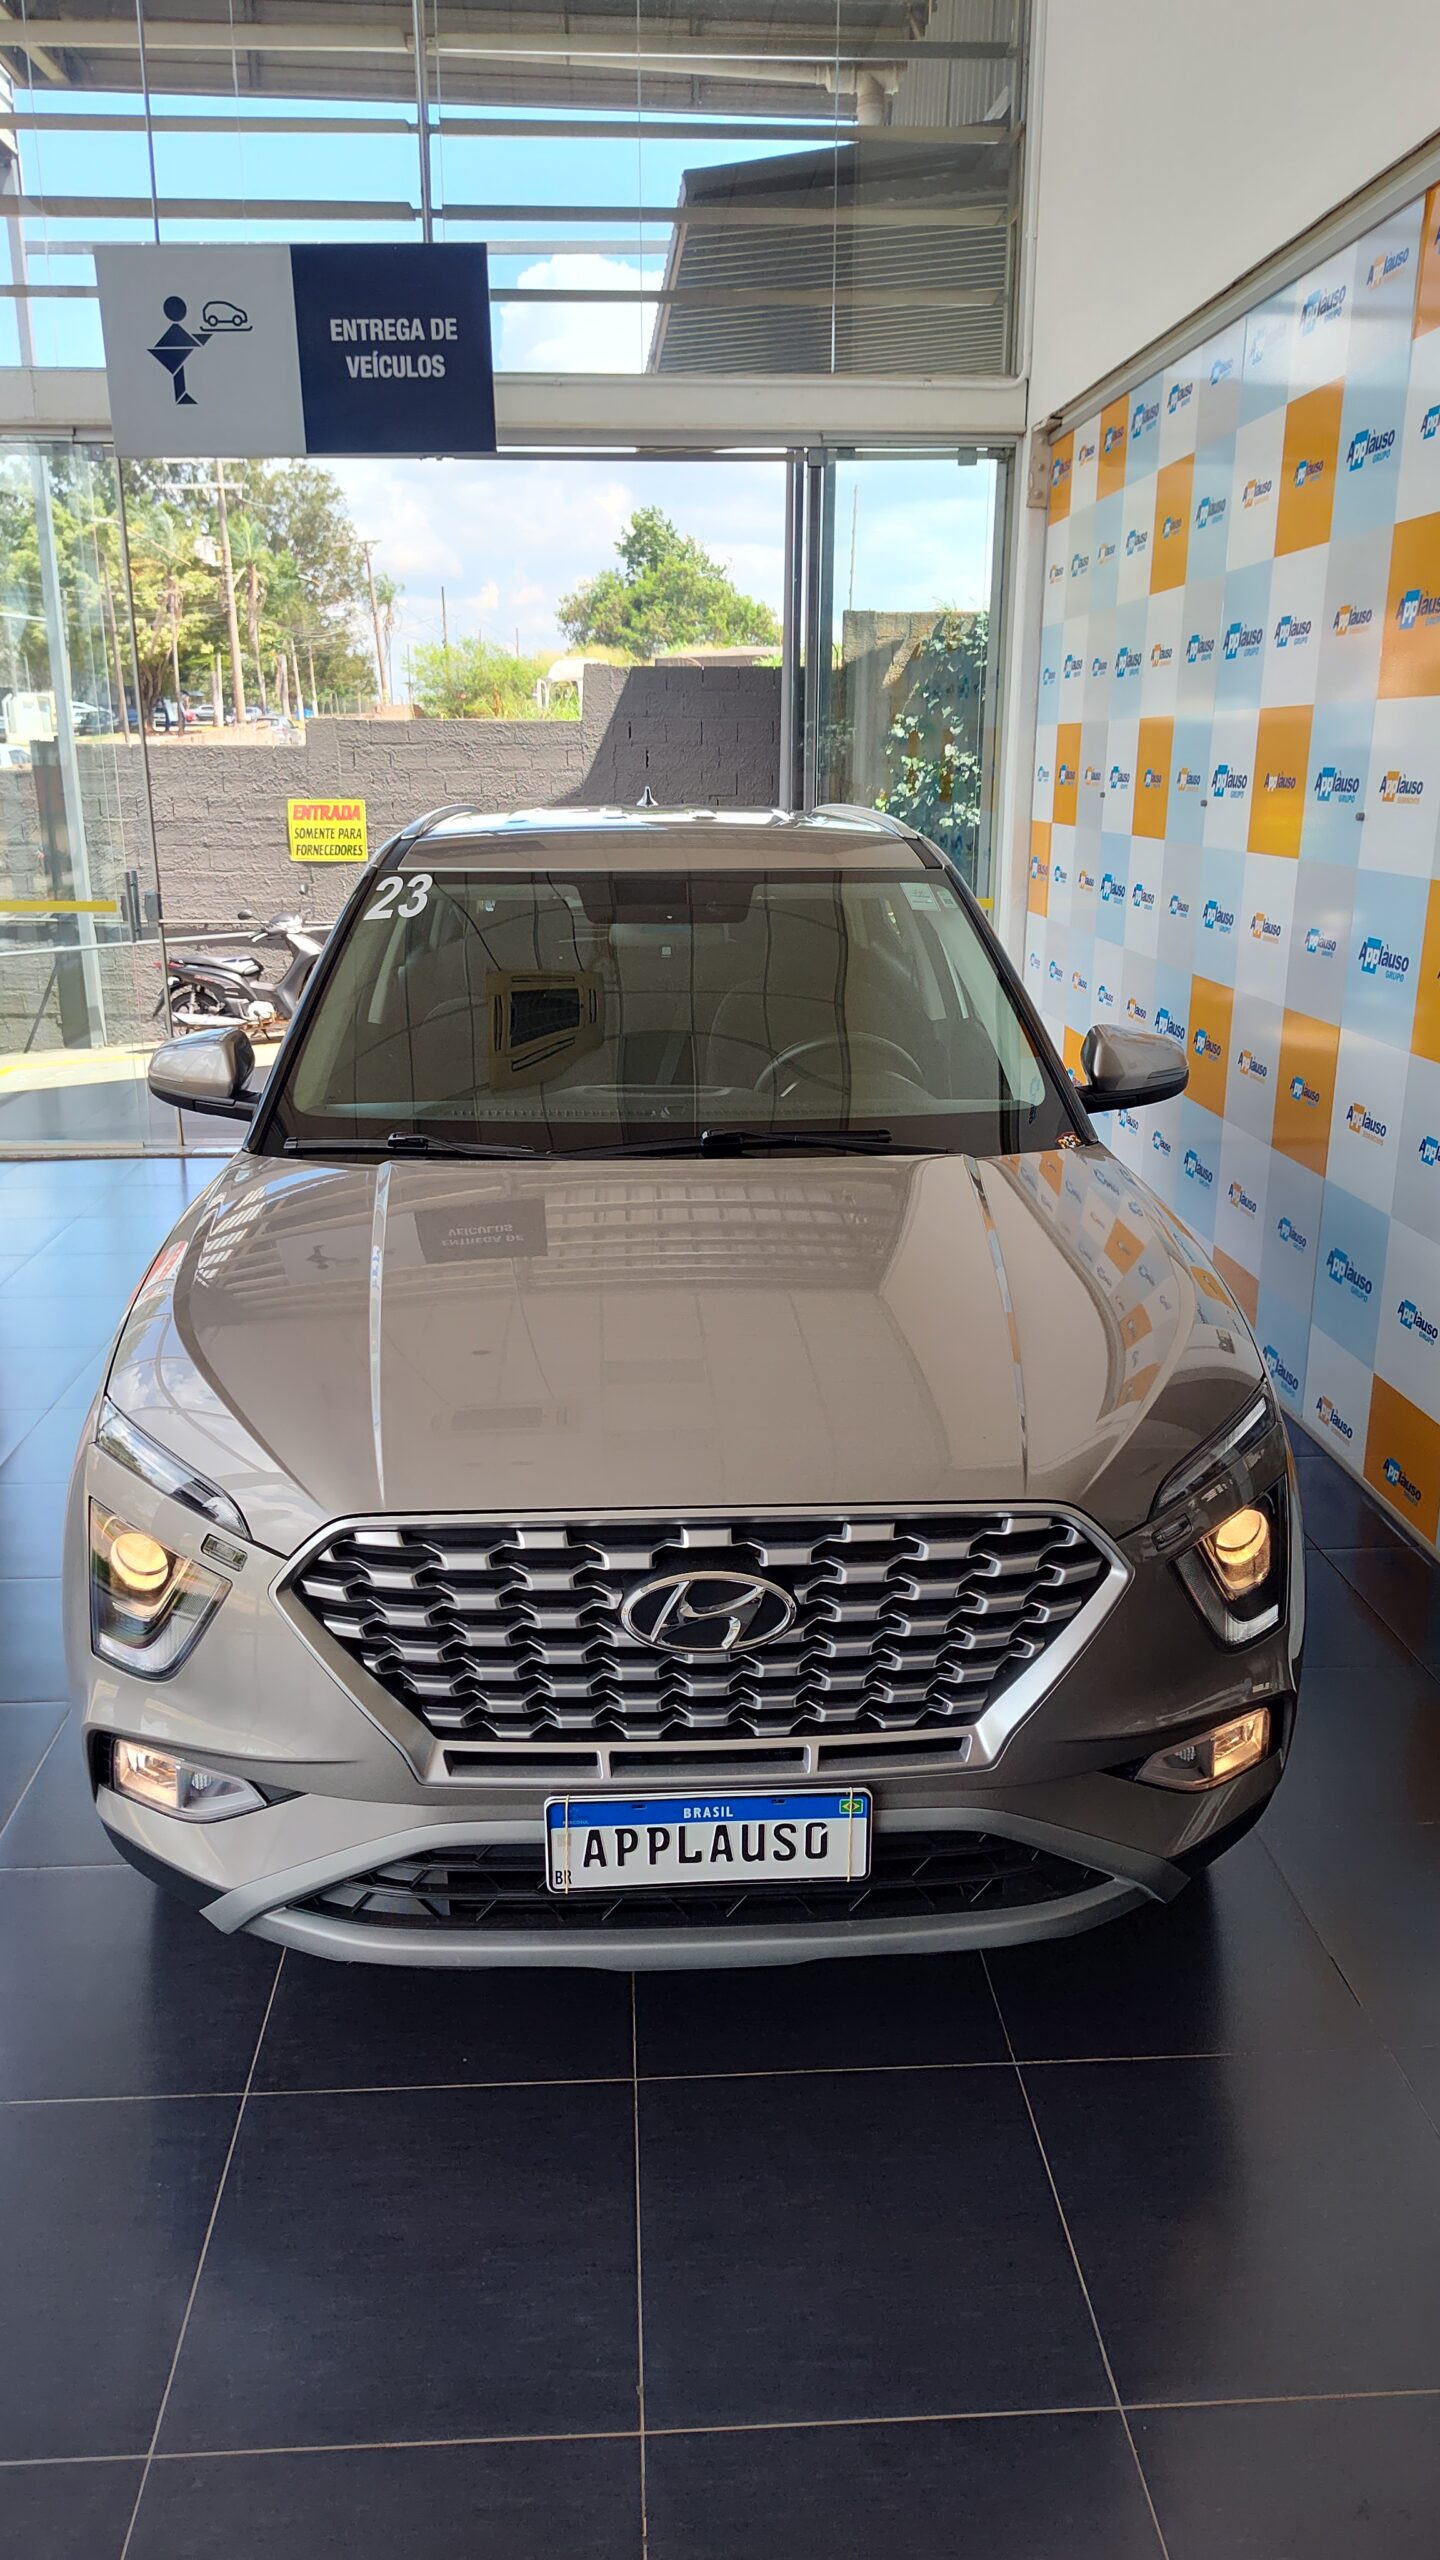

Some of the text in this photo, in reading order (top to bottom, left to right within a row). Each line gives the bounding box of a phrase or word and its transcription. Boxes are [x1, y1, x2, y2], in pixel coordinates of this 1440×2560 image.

[329, 318, 458, 341] ENTREGA DE
[345, 350, 446, 378] VEÍCULOS
[293, 804, 361, 821] ENTRADA
[294, 827, 362, 839] SOMENTE PARA
[296, 844, 363, 856] FORNECEDORES
[363, 874, 433, 920] 23
[1385, 970, 1404, 982] GRUPO
[683, 1806, 734, 1819] BRASIL
[582, 1821, 829, 1868] APPLAUSO
[555, 1870, 572, 1885] BR
